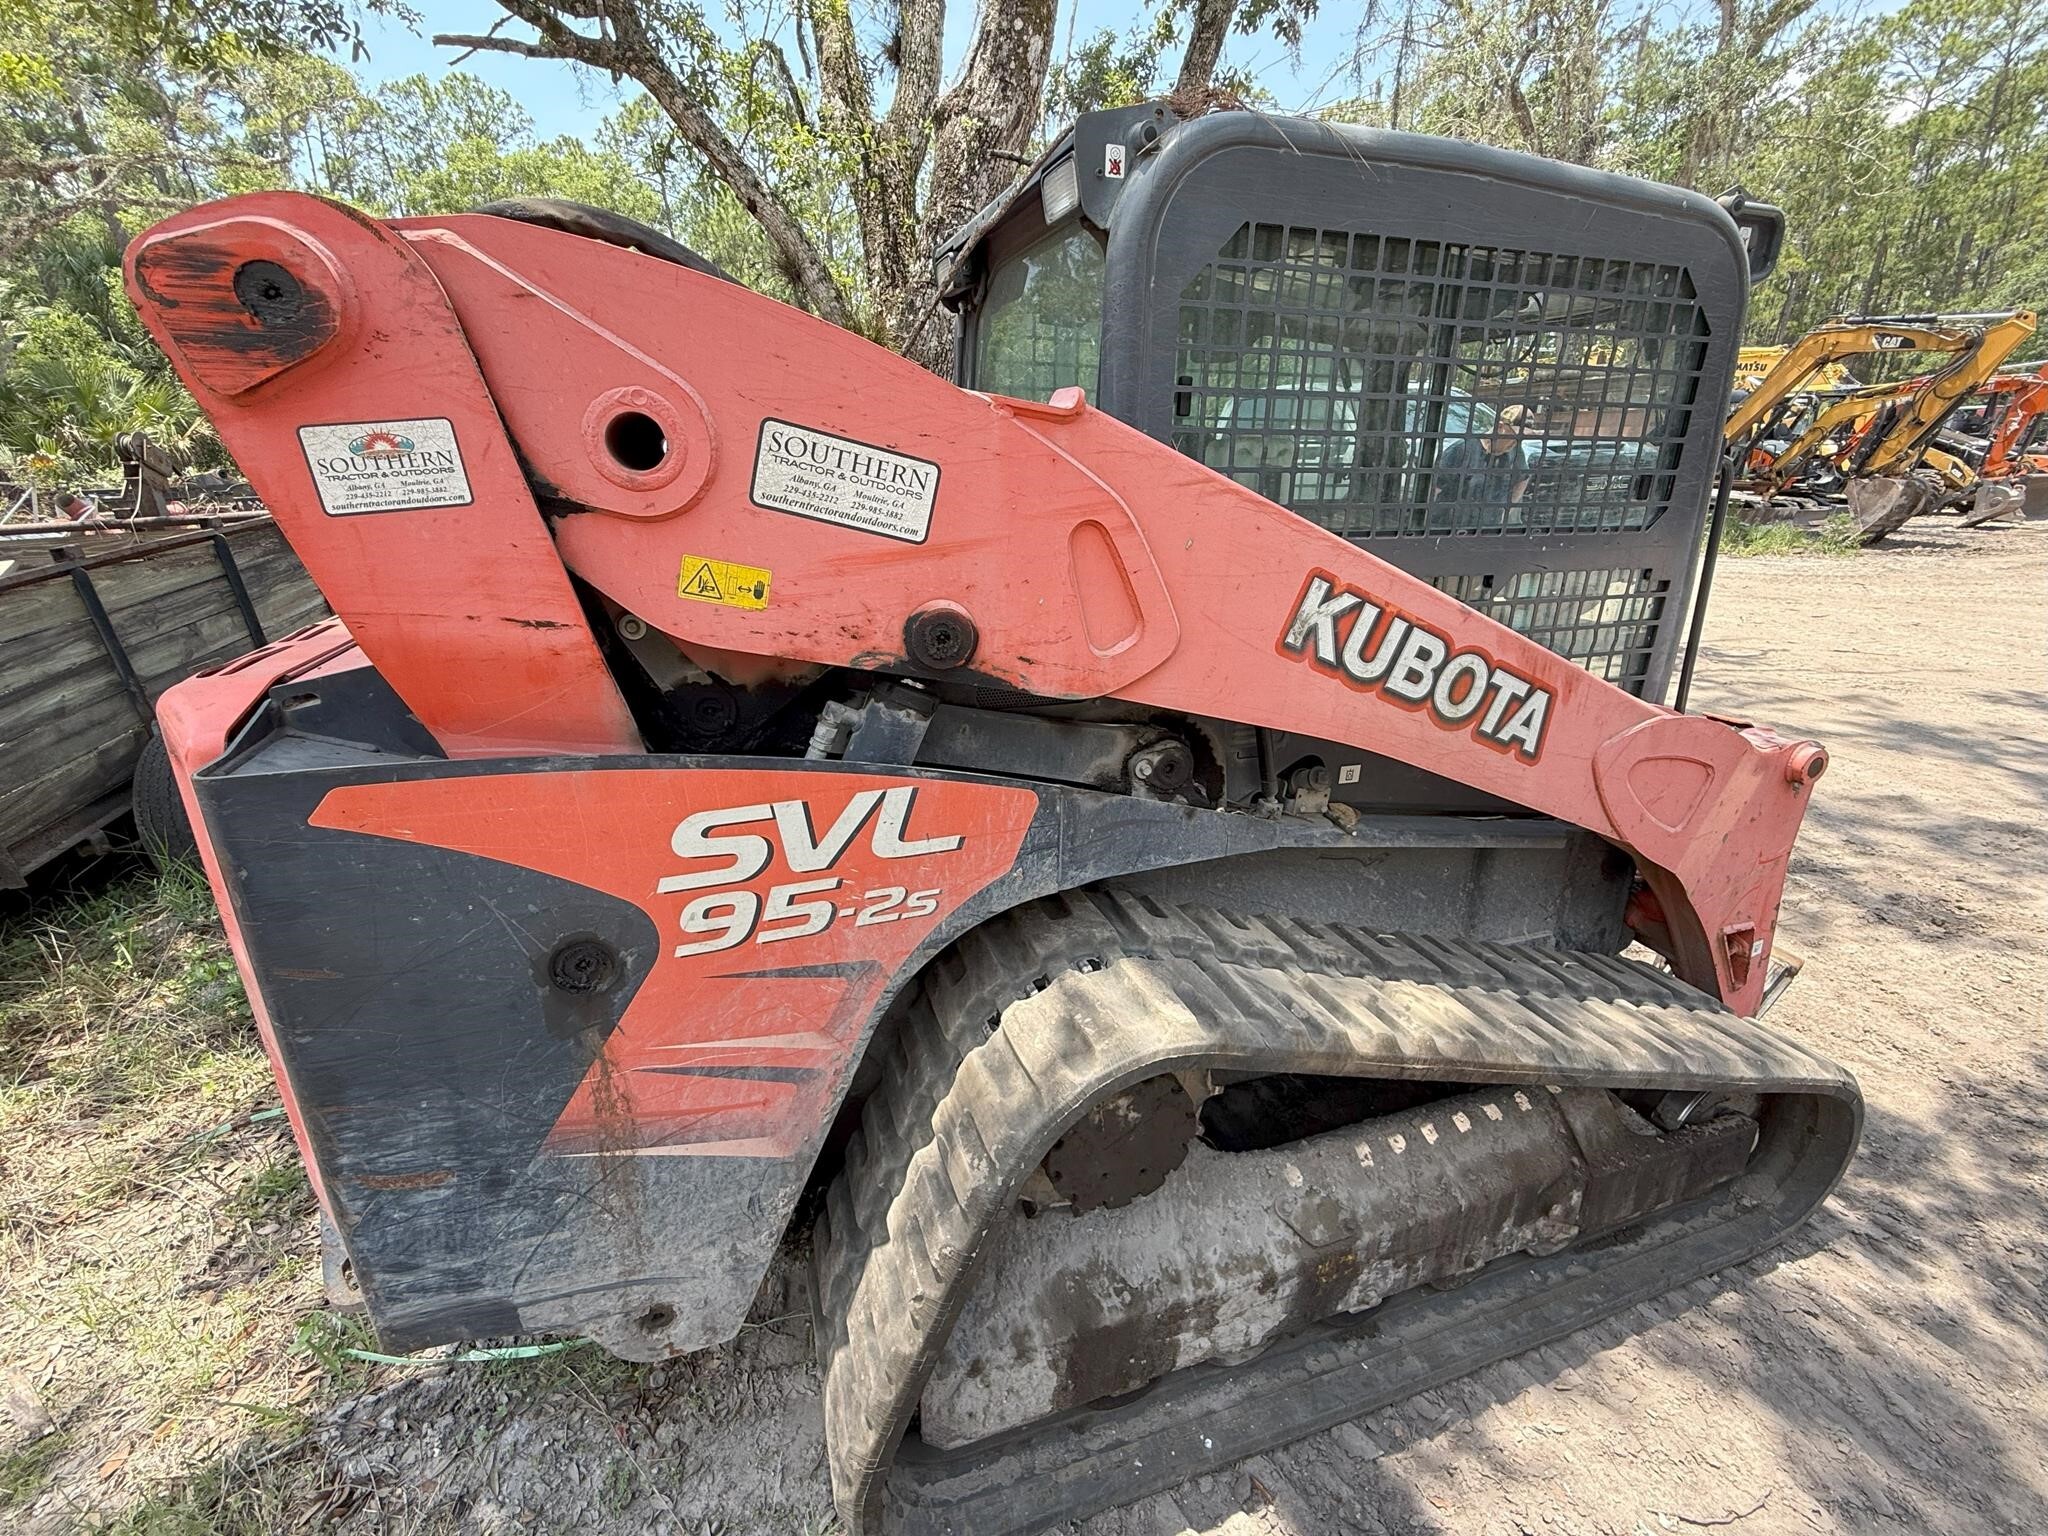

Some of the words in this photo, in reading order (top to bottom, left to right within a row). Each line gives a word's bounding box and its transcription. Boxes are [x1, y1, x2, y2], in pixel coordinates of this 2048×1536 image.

[1881, 336, 1904, 348] CAT
[316, 450, 455, 475] SOUTHERN
[768, 431, 931, 492] SOUTHERN
[324, 472, 379, 482] TRACTOR
[381, 471, 389, 479] &
[391, 466, 455, 477] OUTDOORS
[772, 454, 836, 478] TRACTOR
[837, 472, 847, 481] &
[849, 475, 923, 500] OUTDOORS
[789, 474, 821, 489] Albany,
[823, 482, 837, 492] GA
[332, 494, 466, 511] southerntractorandoutdoors.com
[345, 490, 392, 500] 229-435-2212
[783, 484, 839, 505] 229-435-2212
[853, 489, 890, 506] Moultrie,
[891, 499, 905, 509] GA
[760, 491, 919, 537] southerntractorandoutdoors.com
[850, 501, 904, 521] 229-985-3882
[1283, 576, 1552, 755] KUBOTA
[656, 786, 966, 895] SVL
